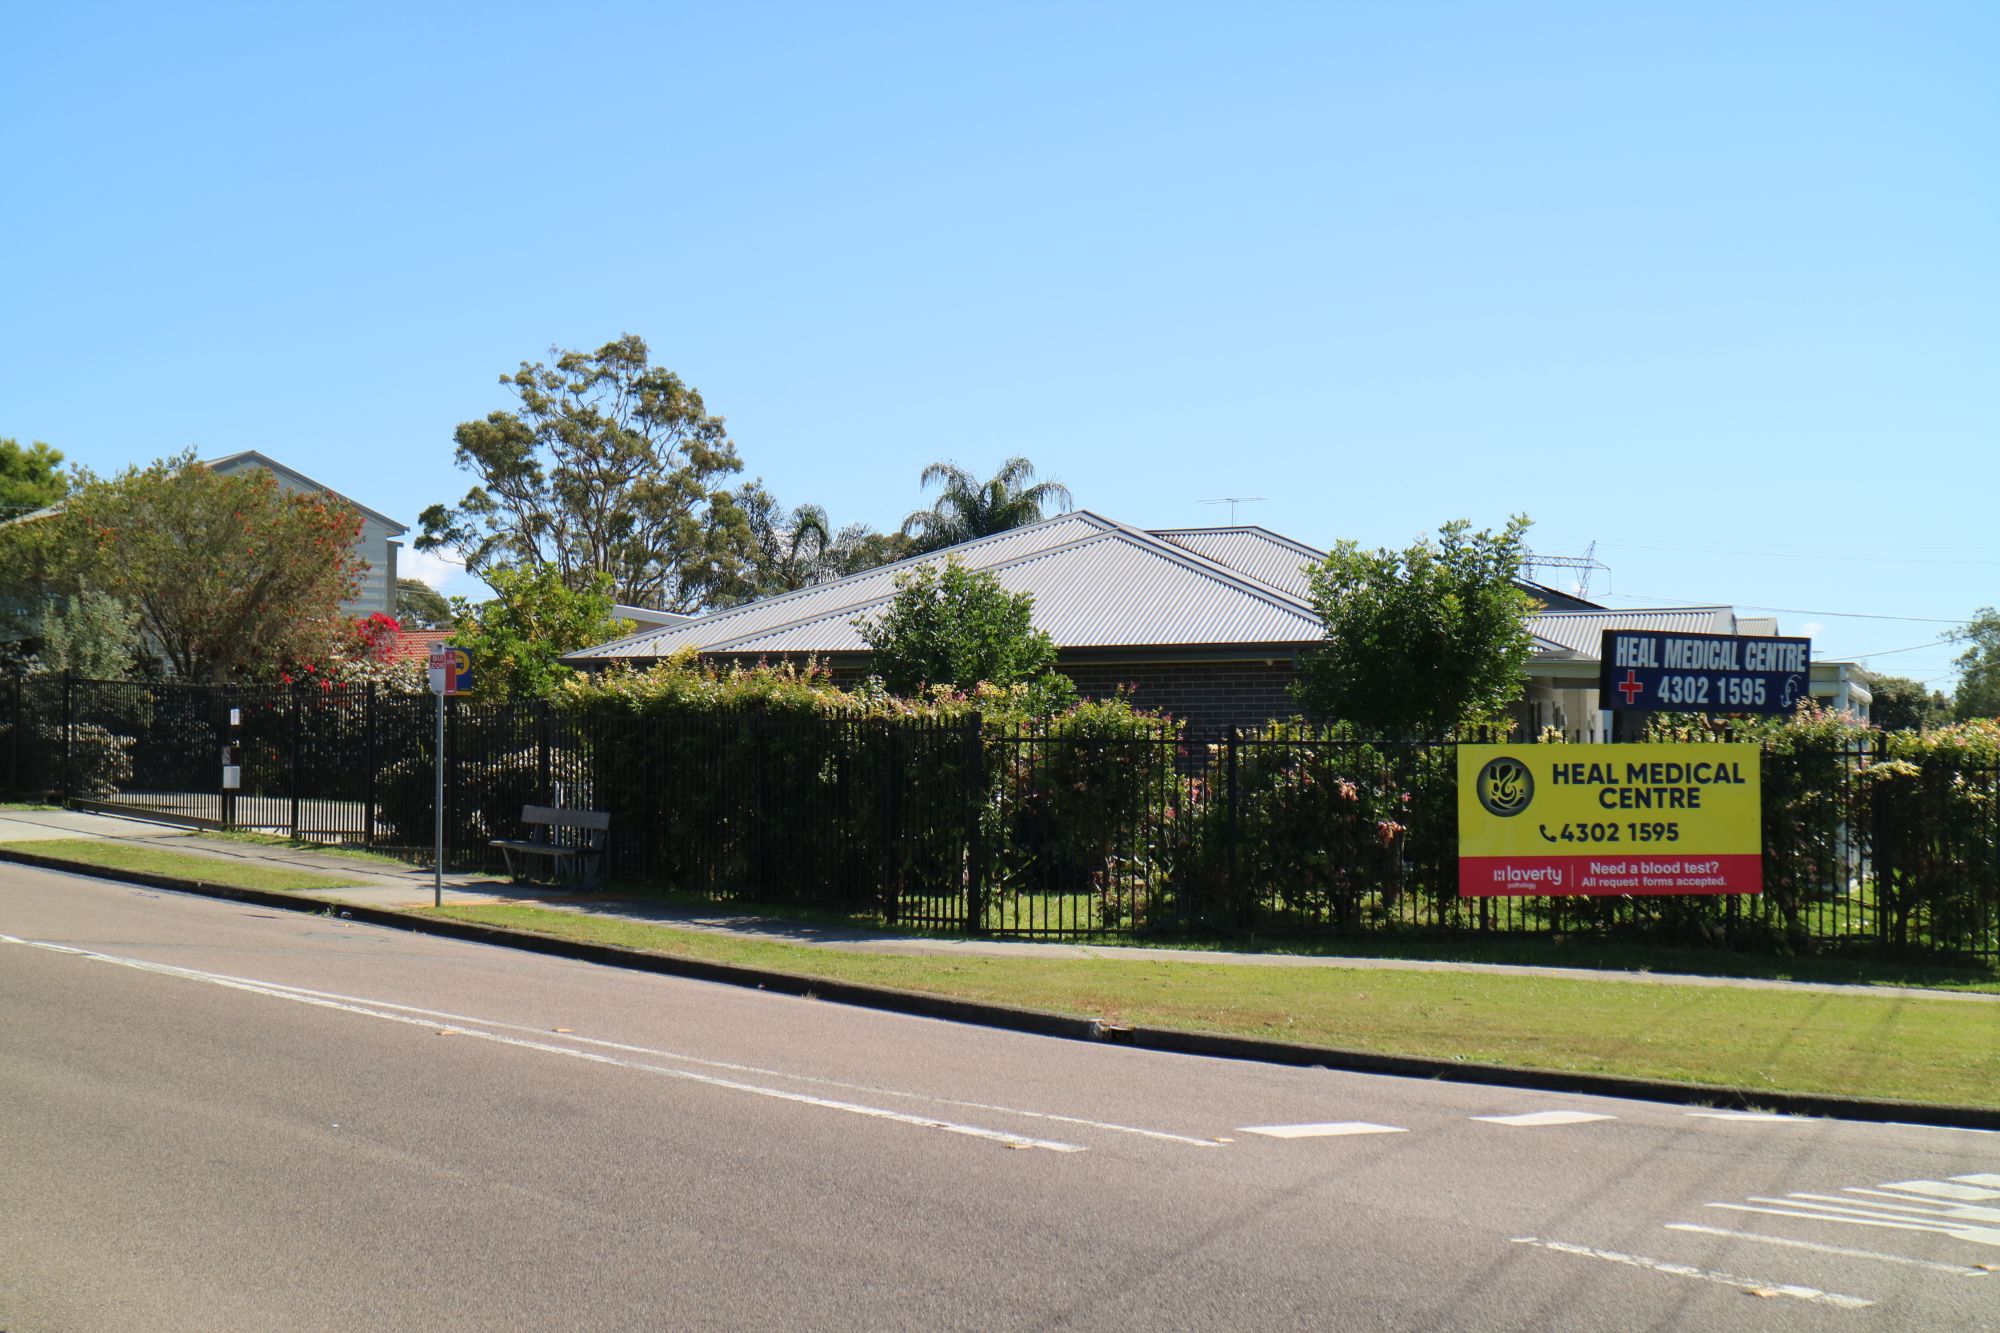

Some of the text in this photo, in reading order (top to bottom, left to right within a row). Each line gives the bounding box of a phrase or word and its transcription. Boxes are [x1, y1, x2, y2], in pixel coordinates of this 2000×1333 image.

[1616, 636, 1807, 672] HEAL MEDICAL CENTRE
[1658, 676, 1765, 705] 4302 1595
[1552, 763, 1745, 784] HEAL MEDICAL
[1599, 788, 1700, 809] CENTRE
[1560, 823, 1679, 842] 4302 1595
[1507, 865, 1562, 885] laverty
[1590, 861, 1719, 875] Need a blood test?
[1582, 876, 1728, 889] All request forms accepted.
